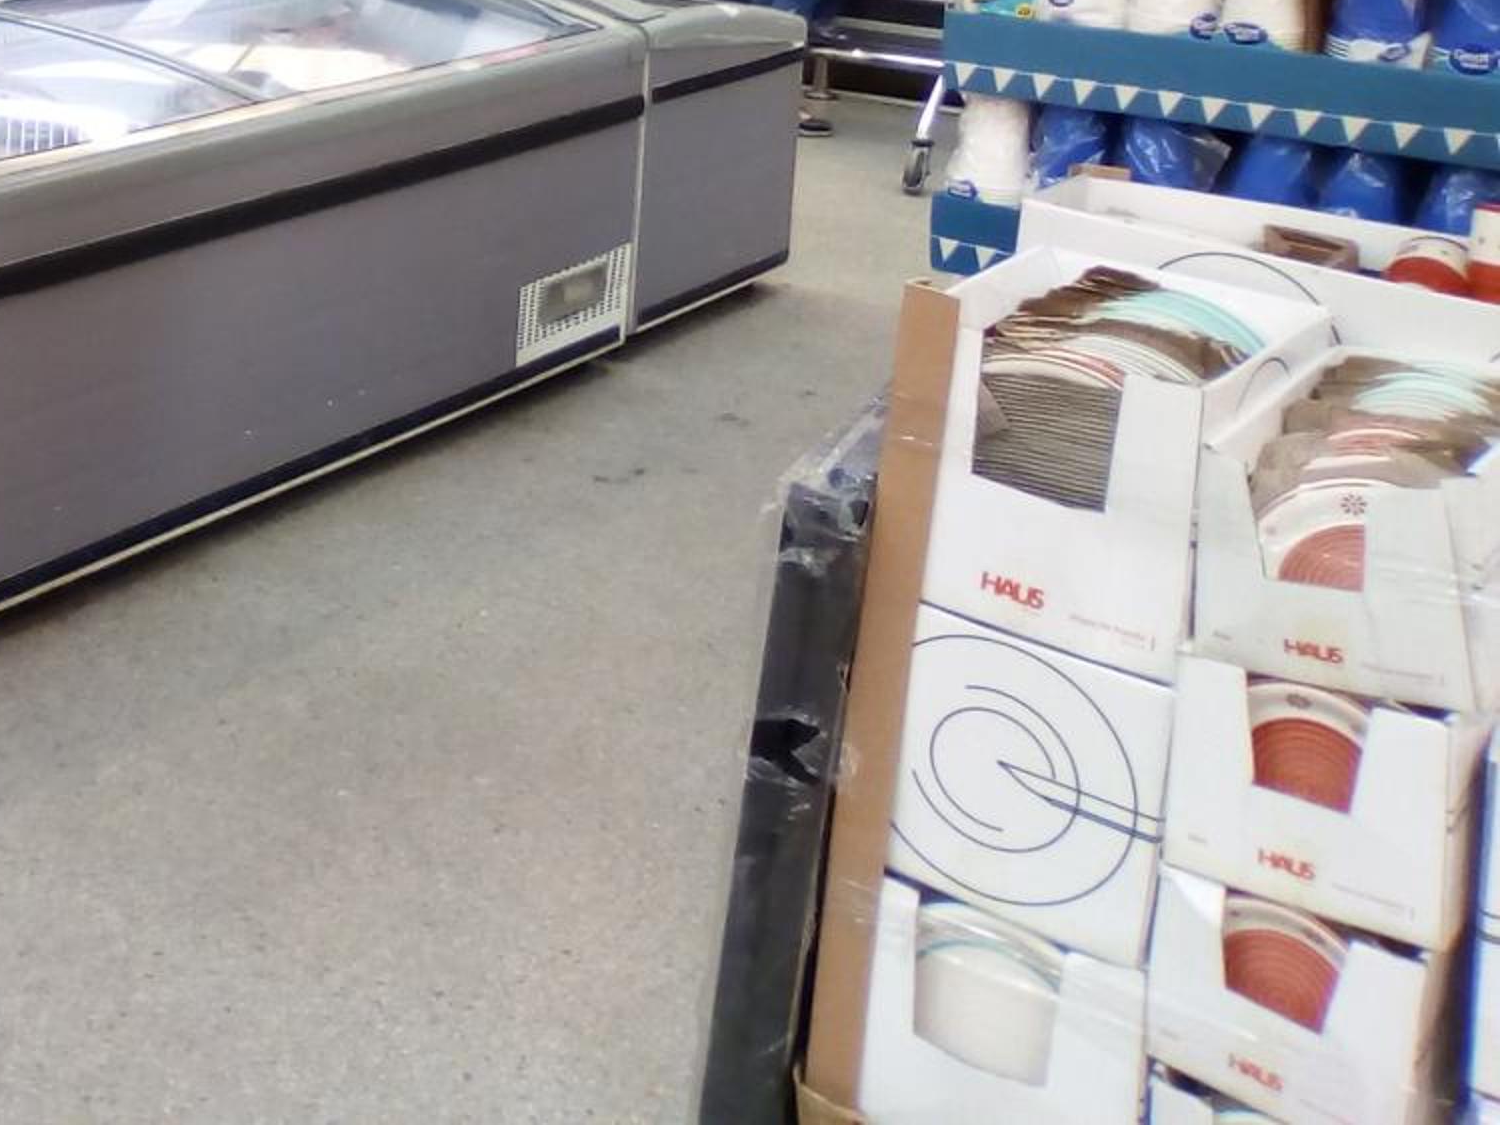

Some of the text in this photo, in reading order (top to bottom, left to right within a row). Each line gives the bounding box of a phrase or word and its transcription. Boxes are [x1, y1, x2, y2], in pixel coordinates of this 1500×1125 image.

[981, 571, 1045, 610] HAUS
[1283, 638, 1344, 665] HAUS
[1257, 848, 1316, 881] HAUS
